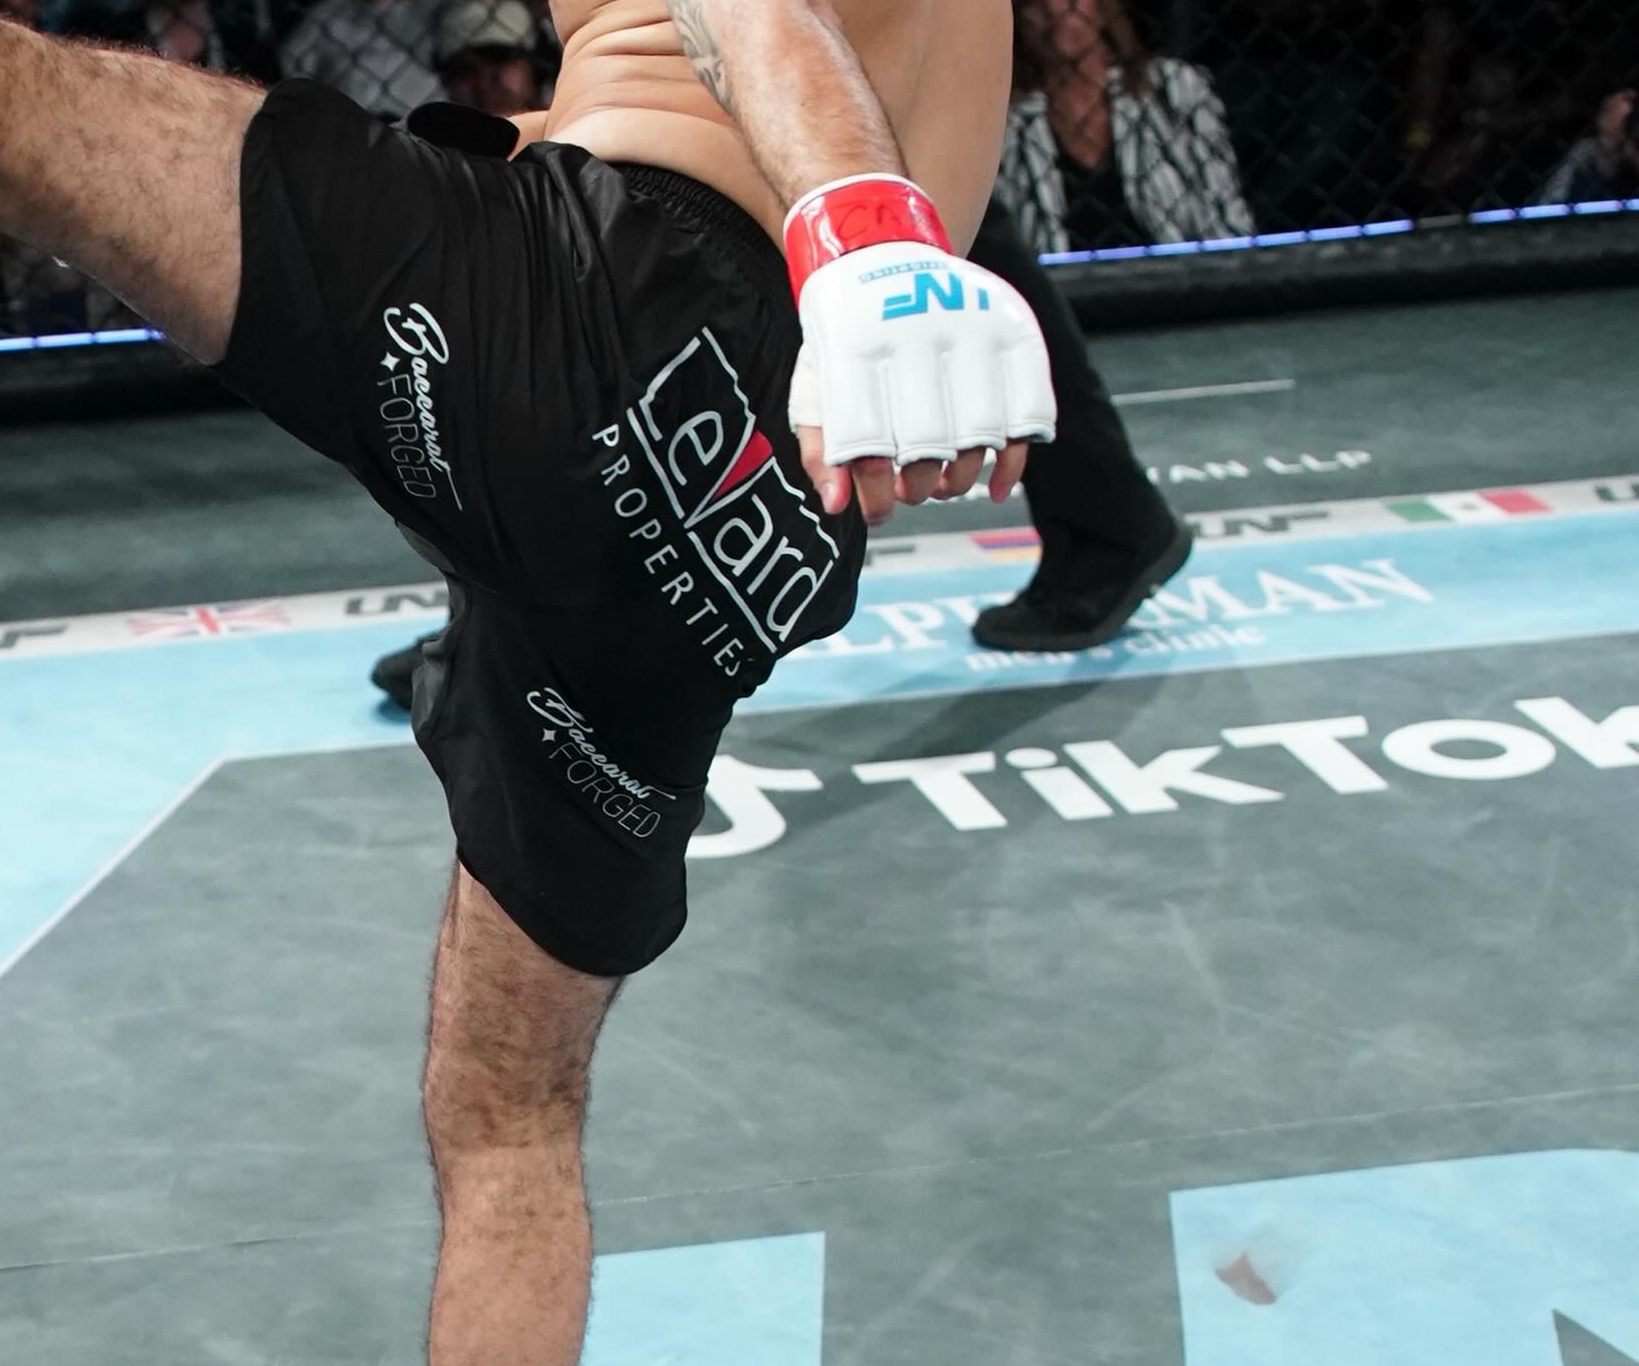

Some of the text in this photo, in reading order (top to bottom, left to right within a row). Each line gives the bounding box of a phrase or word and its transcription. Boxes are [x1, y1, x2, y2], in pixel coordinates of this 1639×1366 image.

[376, 373, 438, 500] FORGED
[384, 302, 462, 511] Baccarat
[550, 741, 662, 838] FORGED
